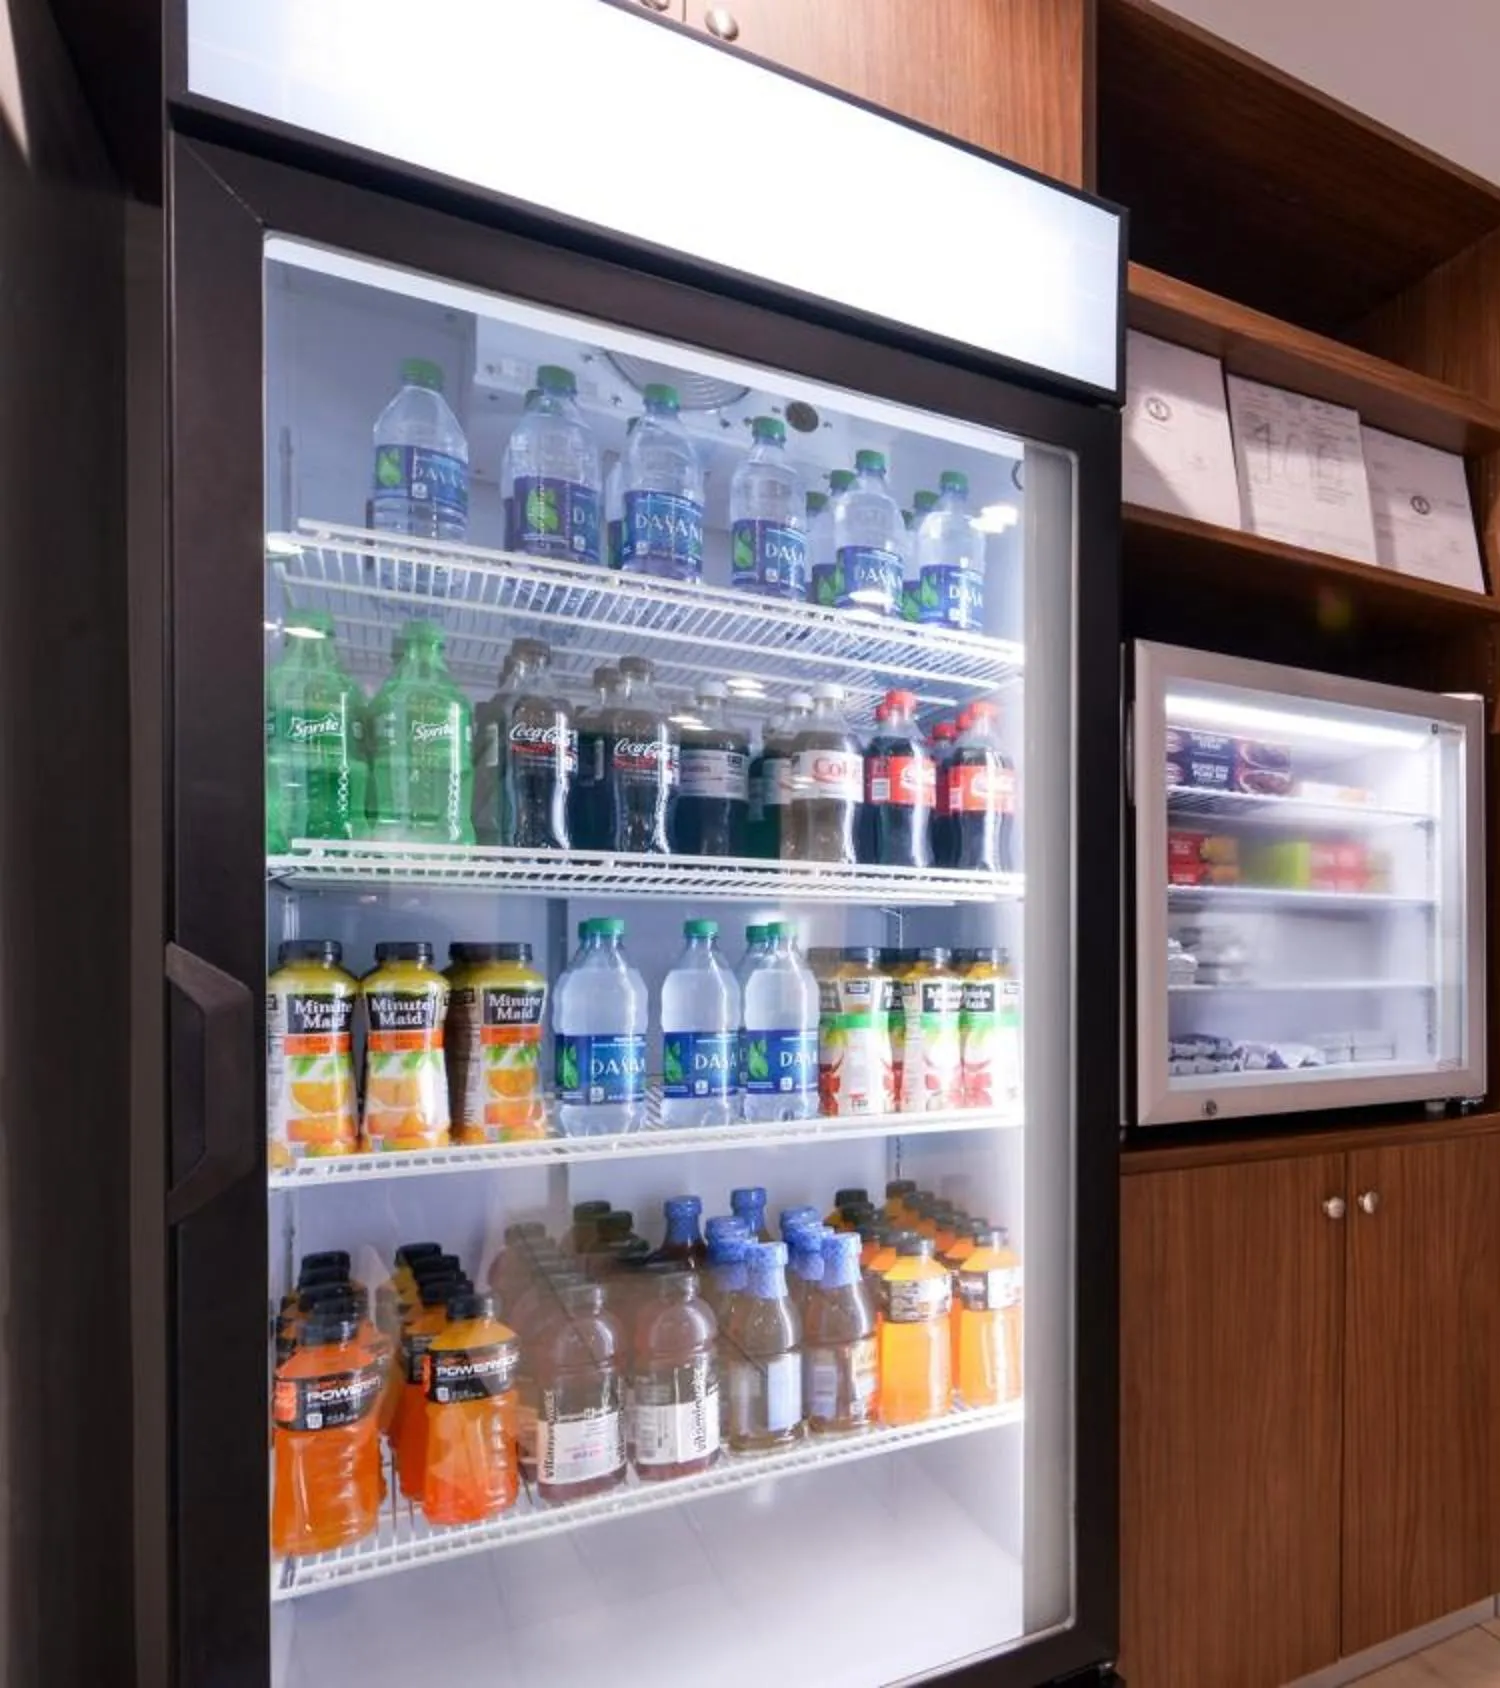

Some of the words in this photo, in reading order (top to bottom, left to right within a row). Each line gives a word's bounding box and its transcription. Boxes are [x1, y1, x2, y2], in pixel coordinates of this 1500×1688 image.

[293, 716, 341, 740] Sprite
[371, 998, 434, 1012] Minute
[379, 1012, 422, 1026] Maid
[497, 1007, 534, 1021] Maid
